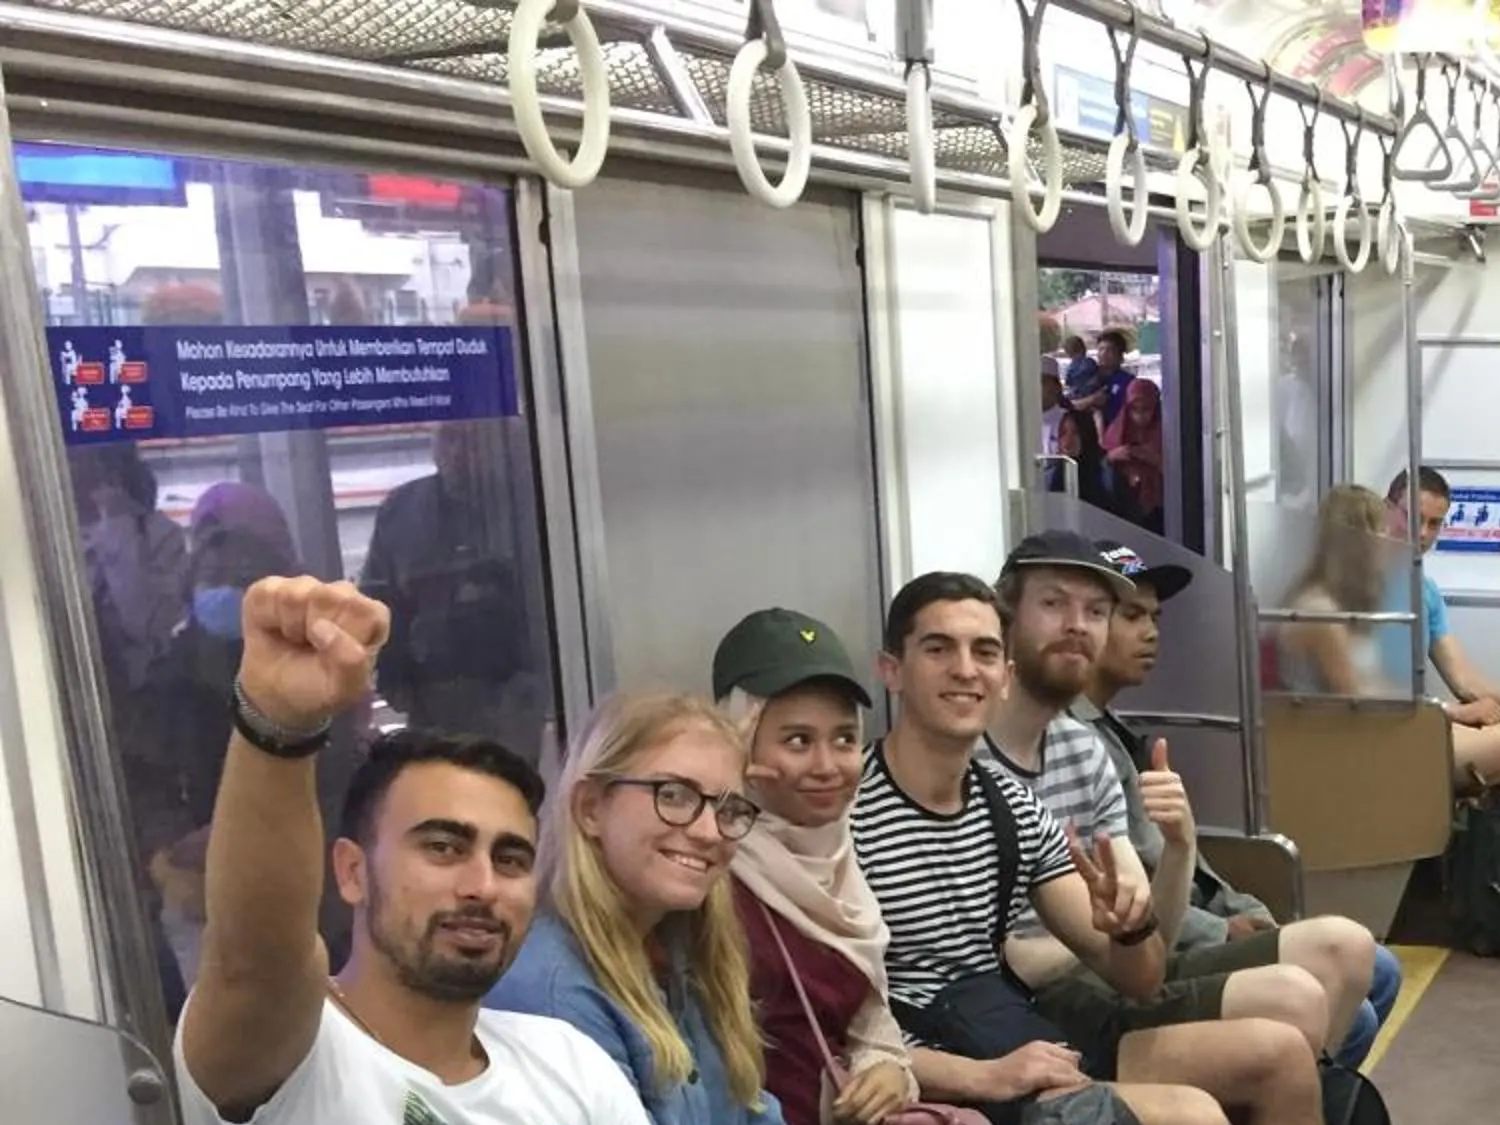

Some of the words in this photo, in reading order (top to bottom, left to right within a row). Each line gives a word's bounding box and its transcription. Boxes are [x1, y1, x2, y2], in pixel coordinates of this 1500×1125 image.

[176, 339, 223, 360] Mohon
[225, 339, 313, 361] Kesadarannya
[314, 338, 347, 357] Untuk
[349, 338, 416, 356] Memberikan
[416, 337, 454, 358] Tempat
[180, 371, 234, 395] Kepada
[235, 369, 311, 392] Penumpang
[312, 367, 342, 391] Yang
[343, 367, 374, 385] Lebih
[375, 366, 449, 384] Membutuhkan
